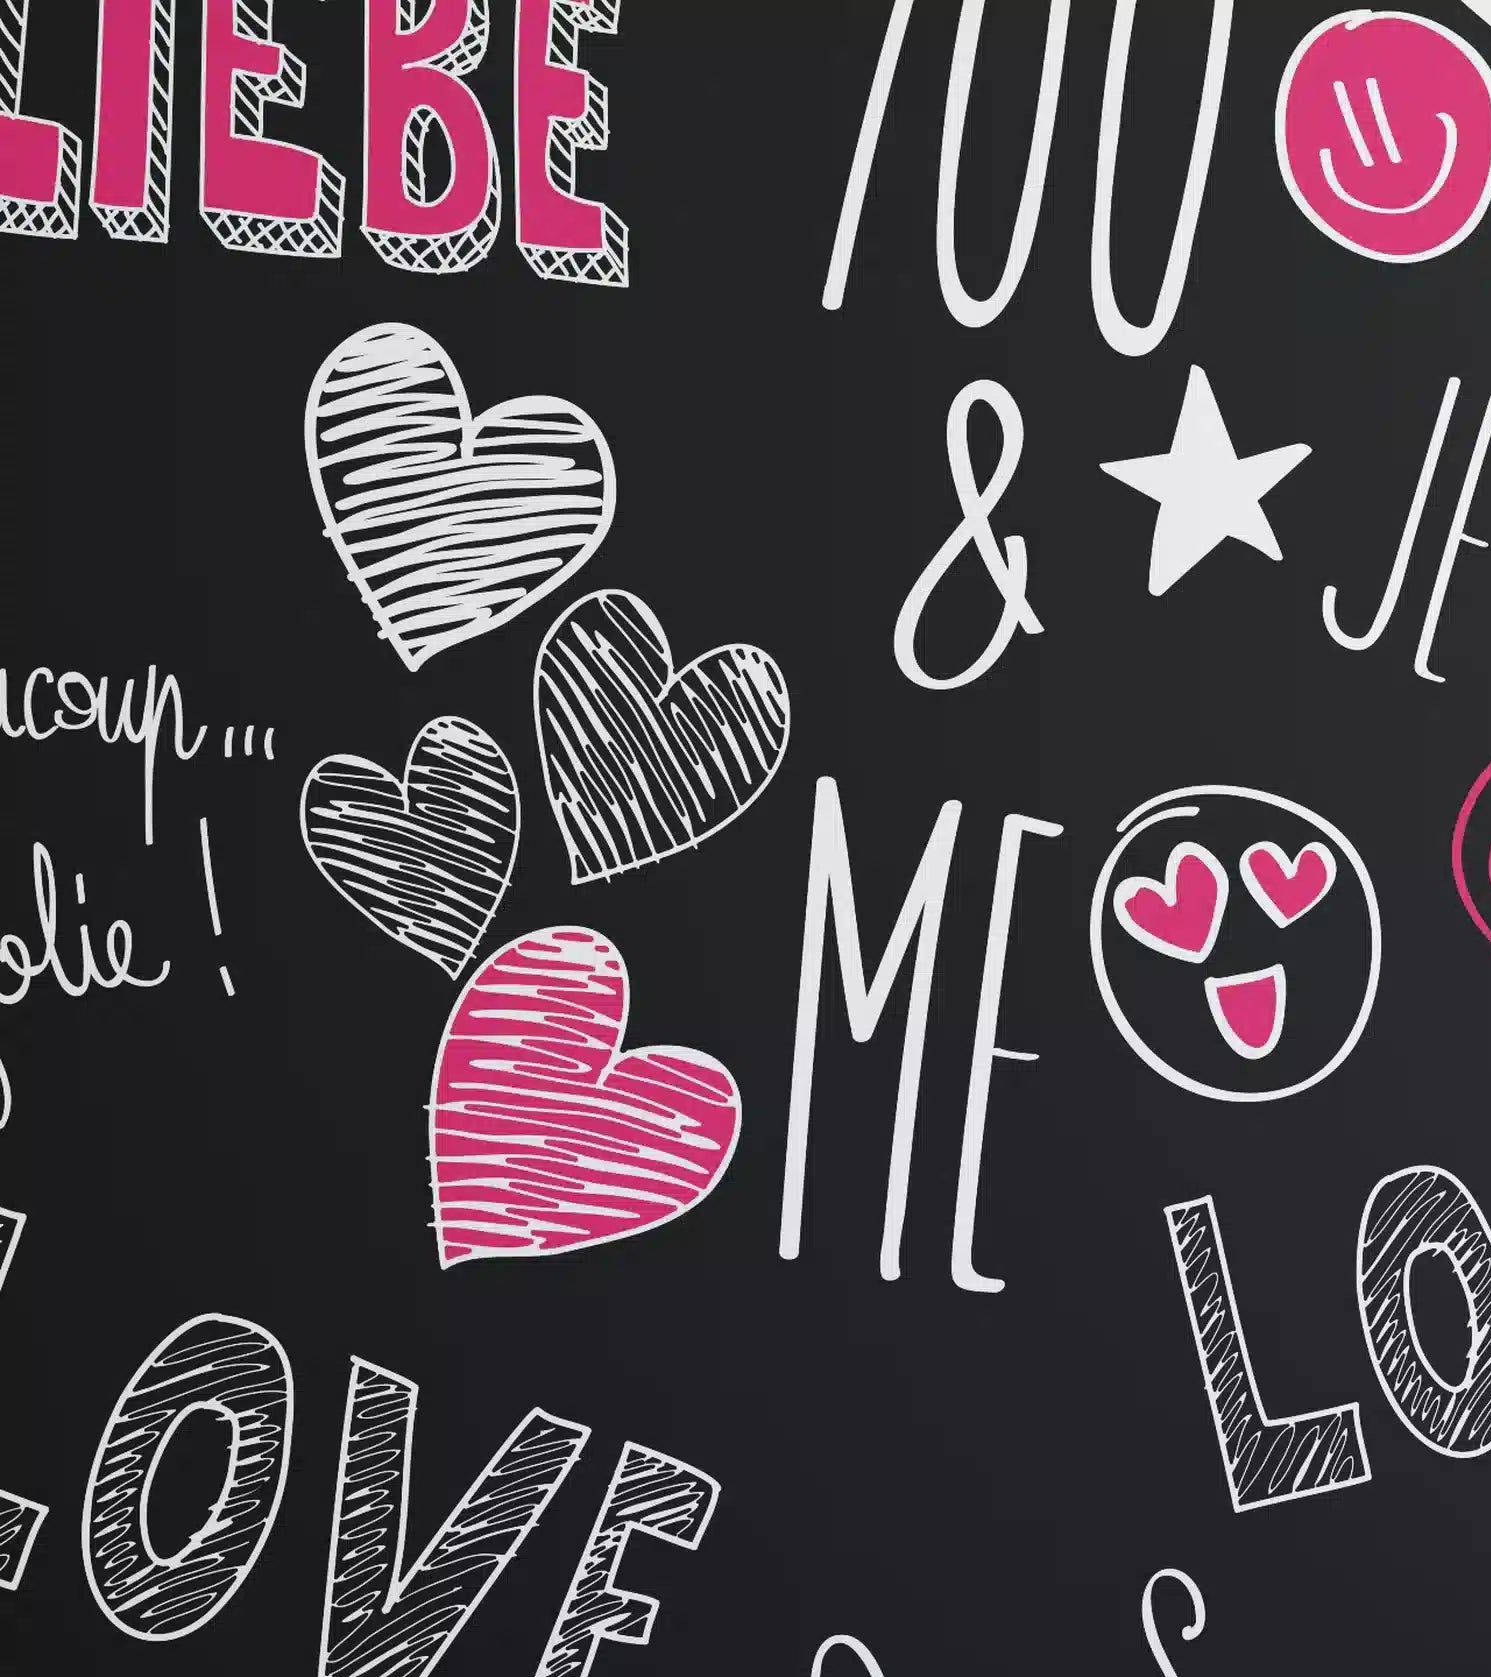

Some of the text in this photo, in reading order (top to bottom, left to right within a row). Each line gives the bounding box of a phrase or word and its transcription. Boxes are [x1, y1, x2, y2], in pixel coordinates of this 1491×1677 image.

[893, 379, 1046, 691] &
[0, 840, 171, 1006] olie
[778, 775, 1065, 1295] ME
